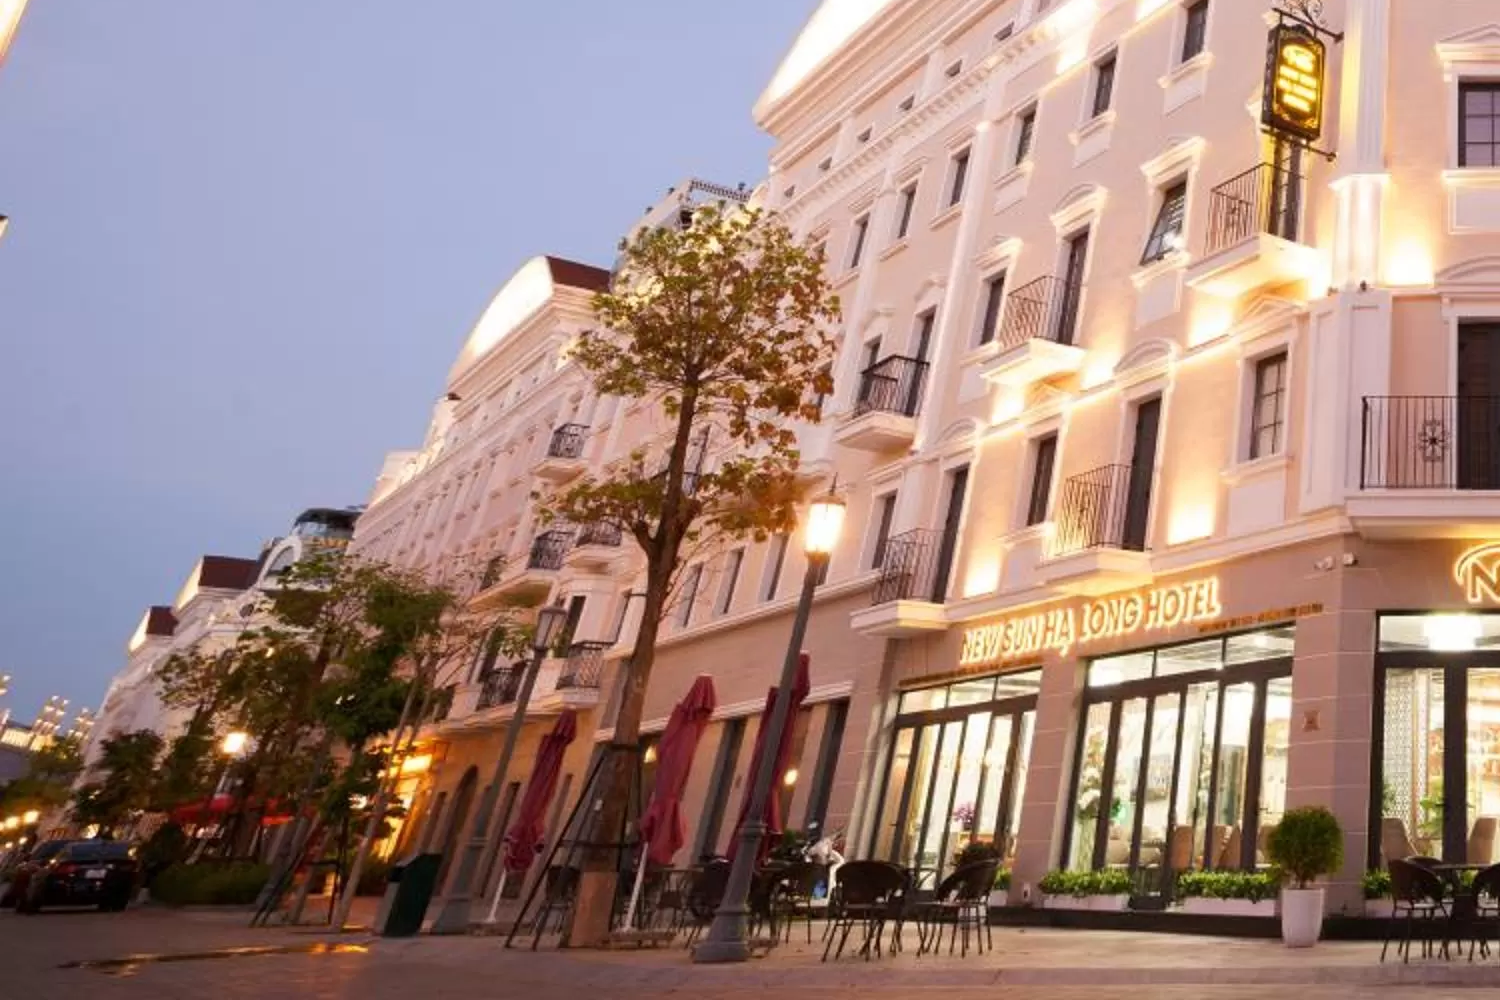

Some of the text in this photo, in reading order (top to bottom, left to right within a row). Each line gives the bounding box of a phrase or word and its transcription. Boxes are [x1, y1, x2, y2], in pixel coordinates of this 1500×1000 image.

[960, 624, 1004, 664] NEW
[1001, 614, 1046, 657] SUN
[1079, 592, 1142, 643] LONG
[1143, 575, 1222, 632] HOTEL
